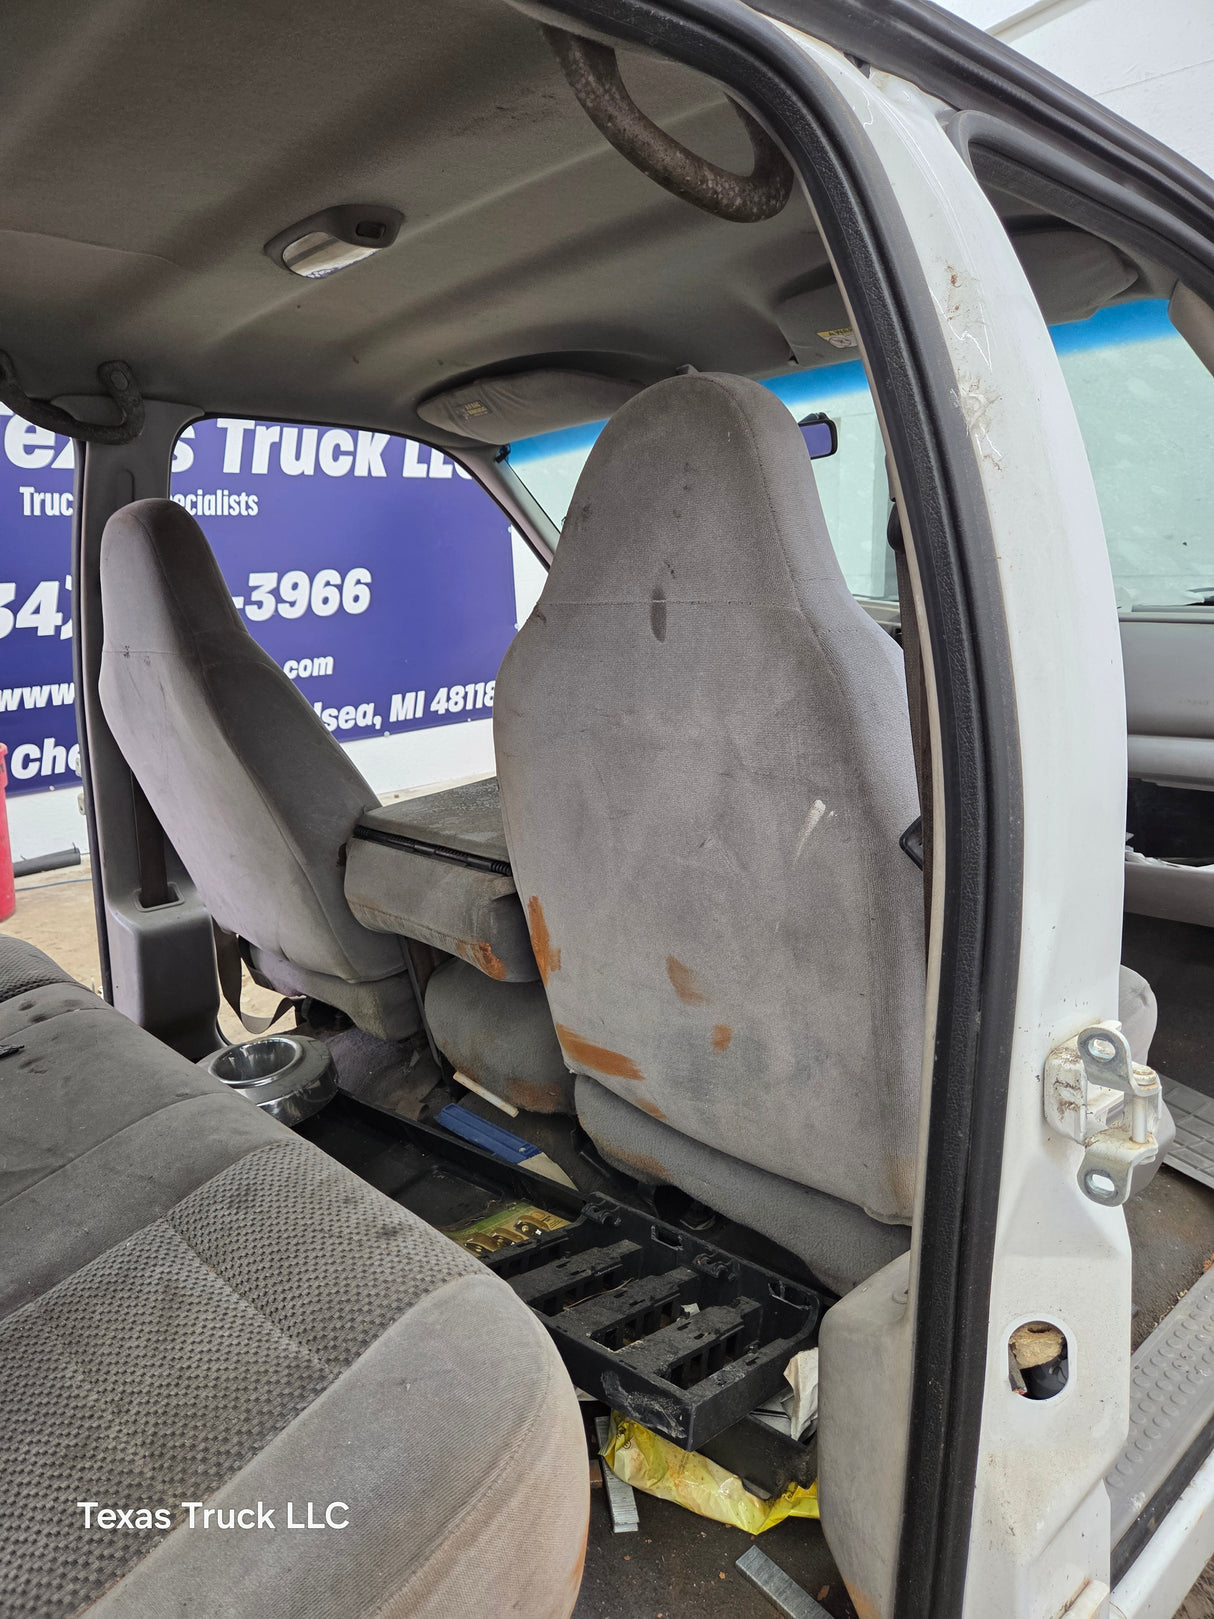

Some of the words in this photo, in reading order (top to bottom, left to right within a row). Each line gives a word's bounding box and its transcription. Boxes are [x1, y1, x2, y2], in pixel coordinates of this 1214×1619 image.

[216, 417, 390, 477] Truck
[19, 486, 73, 516] Truc
[389, 690, 425, 722] MI
[430, 680, 497, 715] 48118
